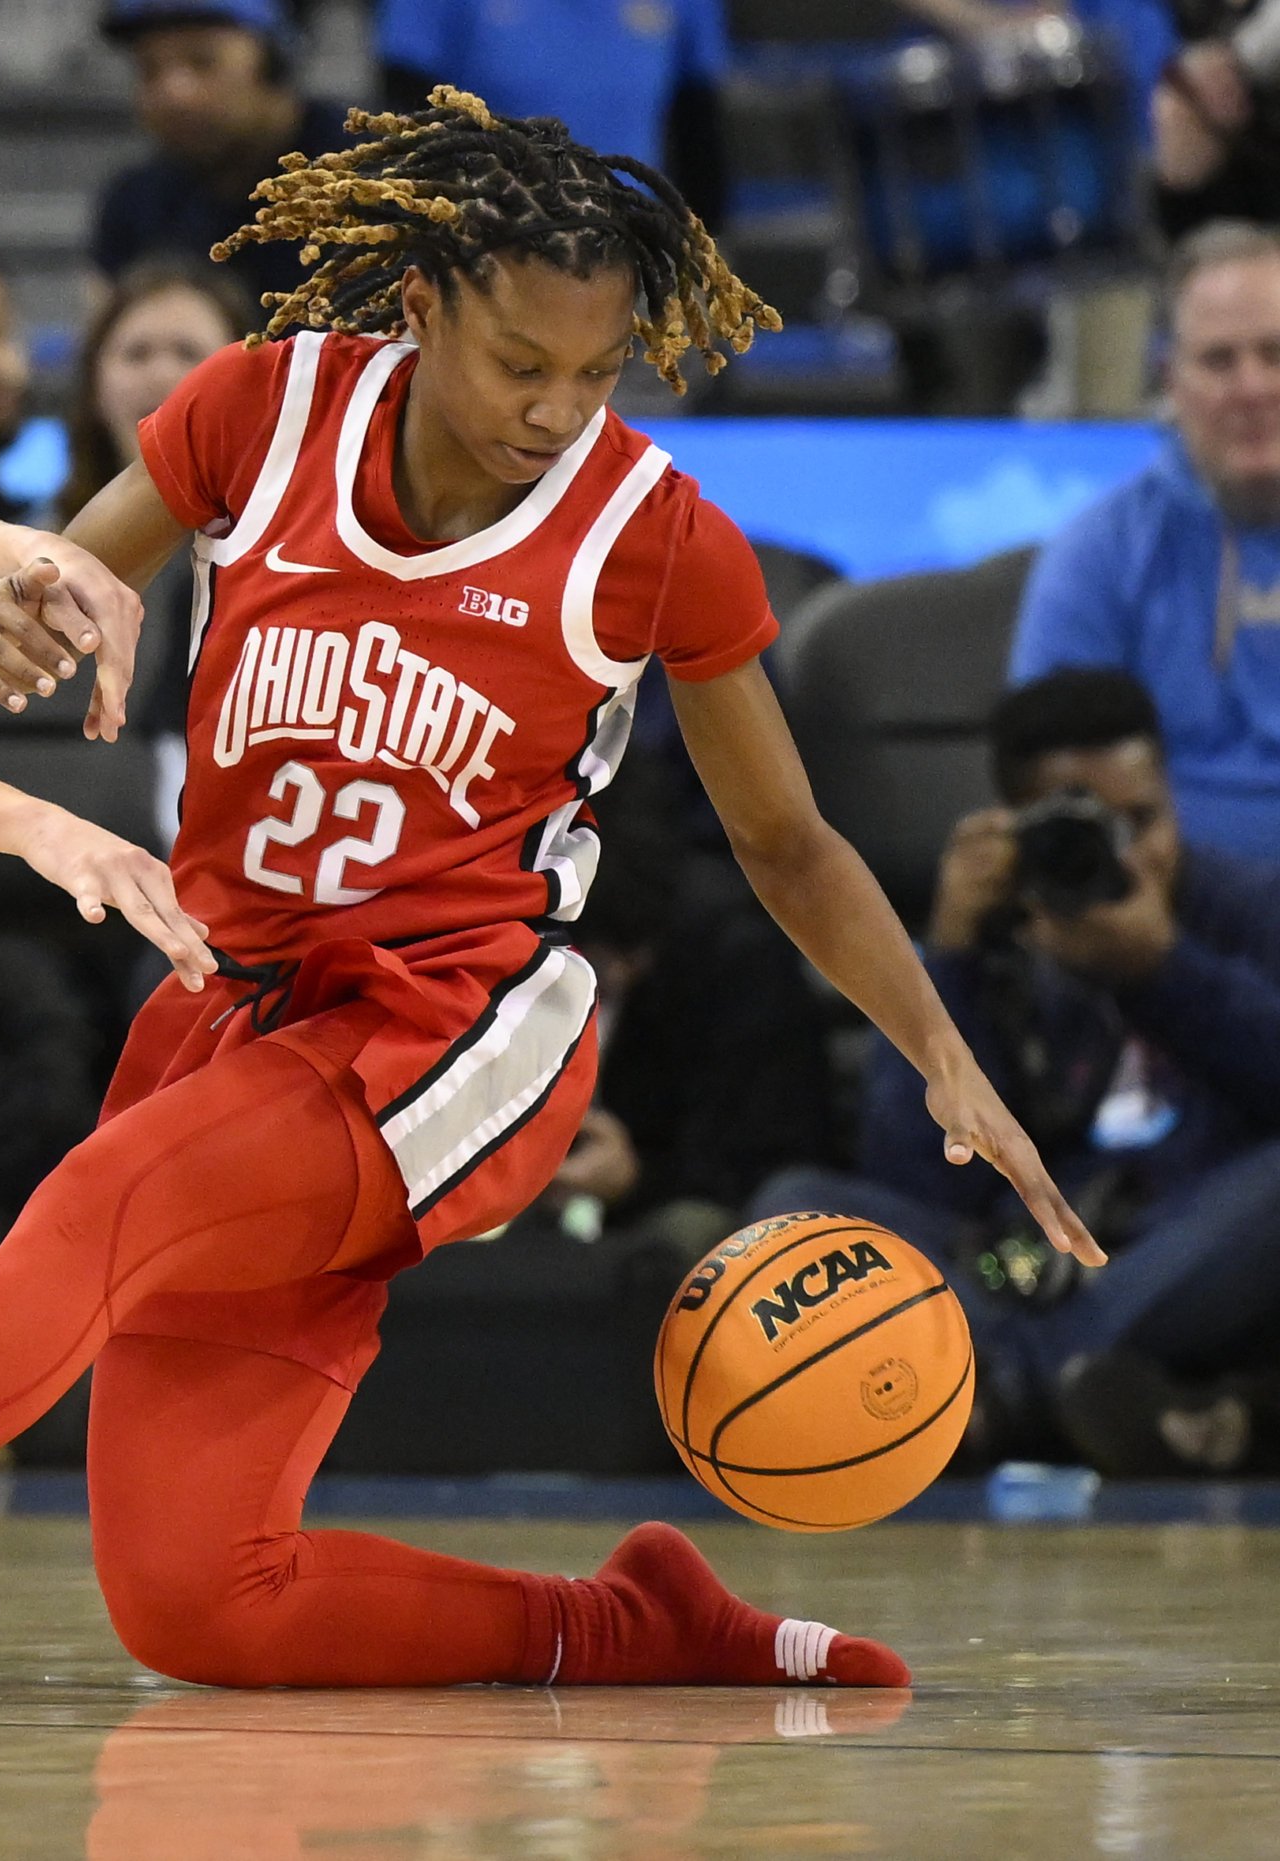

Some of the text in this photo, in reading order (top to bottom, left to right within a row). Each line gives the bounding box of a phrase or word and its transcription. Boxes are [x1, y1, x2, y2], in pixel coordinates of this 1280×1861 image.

[213, 620, 516, 830] OHIO STATE
[243, 760, 406, 906] 22
[750, 1240, 894, 1343] NCAA
[773, 1275, 900, 1352] OFFICIAL GAME BALL
